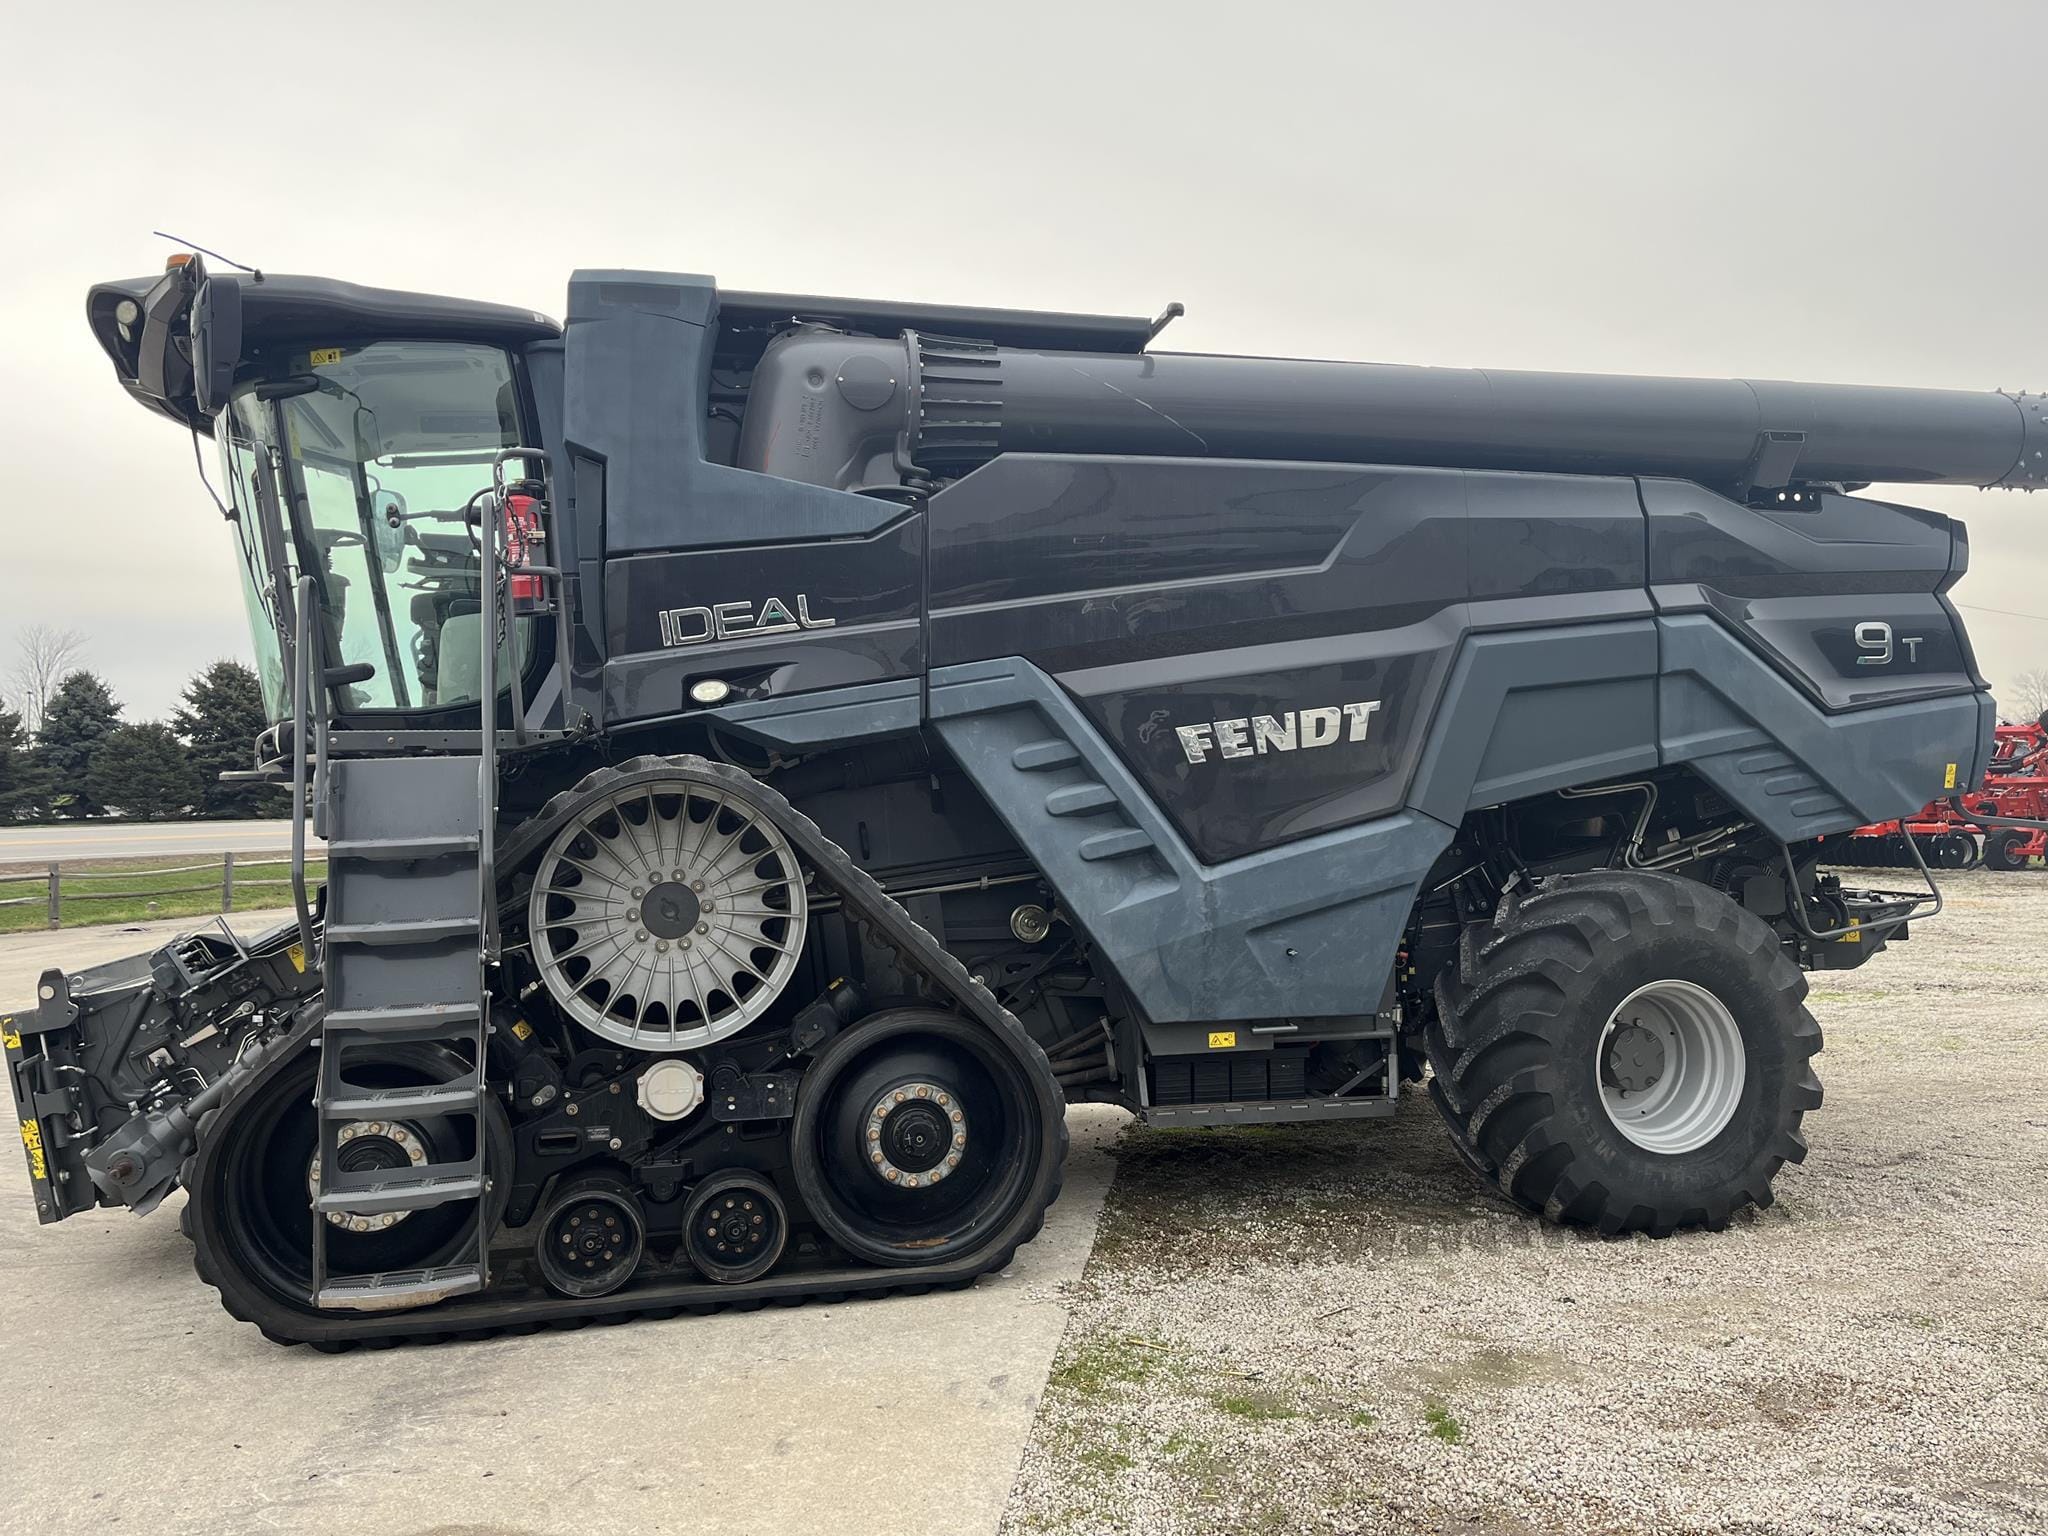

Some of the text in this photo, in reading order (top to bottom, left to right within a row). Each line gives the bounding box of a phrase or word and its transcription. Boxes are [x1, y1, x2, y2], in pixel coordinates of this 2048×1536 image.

[659, 594, 836, 647] IDEAL
[1855, 622, 1923, 664] 9 T
[1175, 700, 1381, 764] FENDT
